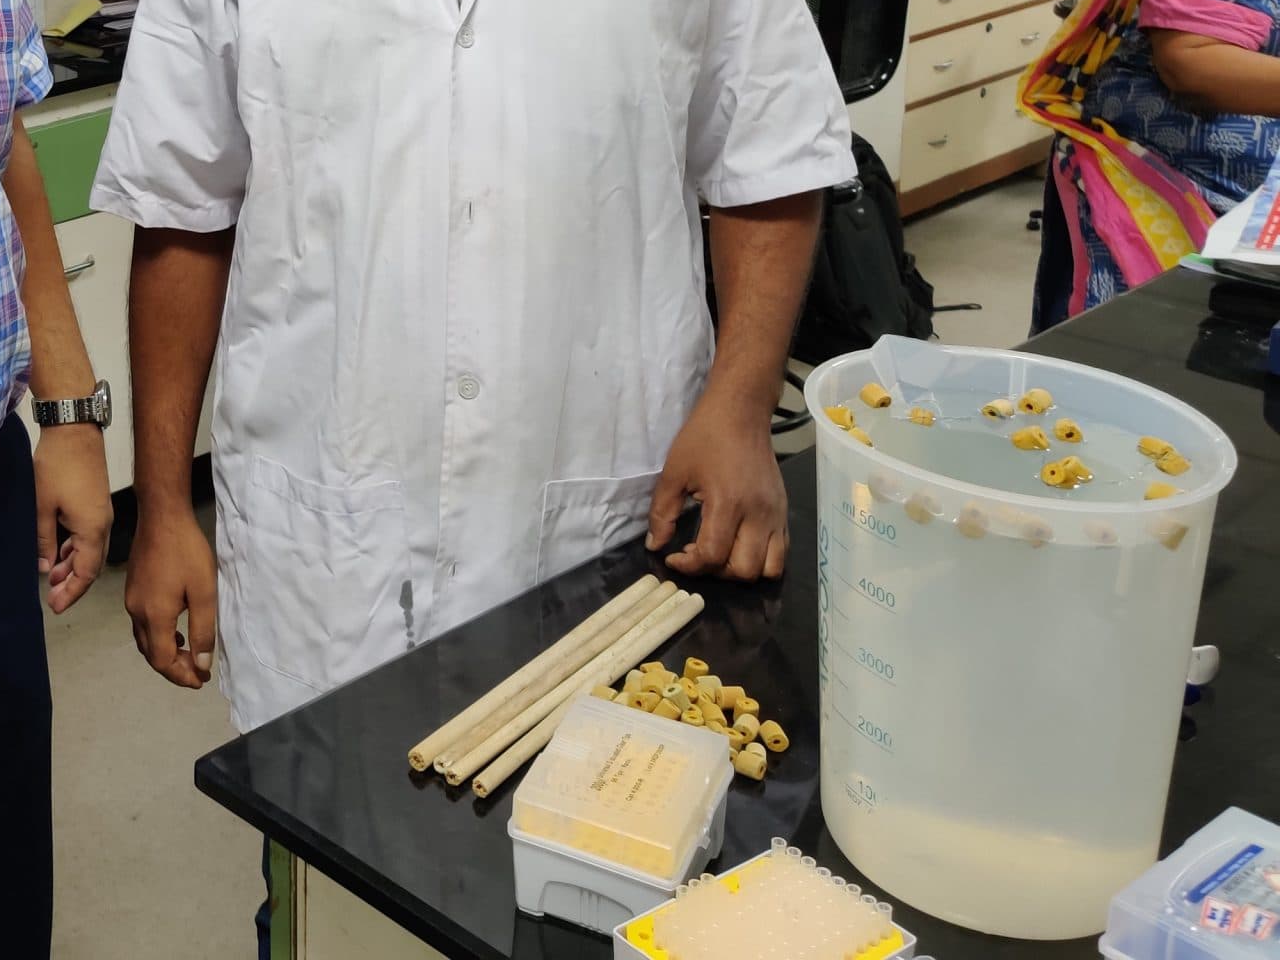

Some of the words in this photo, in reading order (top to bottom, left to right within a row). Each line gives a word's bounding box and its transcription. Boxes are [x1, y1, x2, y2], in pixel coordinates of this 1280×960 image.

[860, 510, 896, 540] 5000
[858, 577, 896, 608] 4000
[858, 647, 895, 679] 3000
[858, 714, 893, 747] 2000
